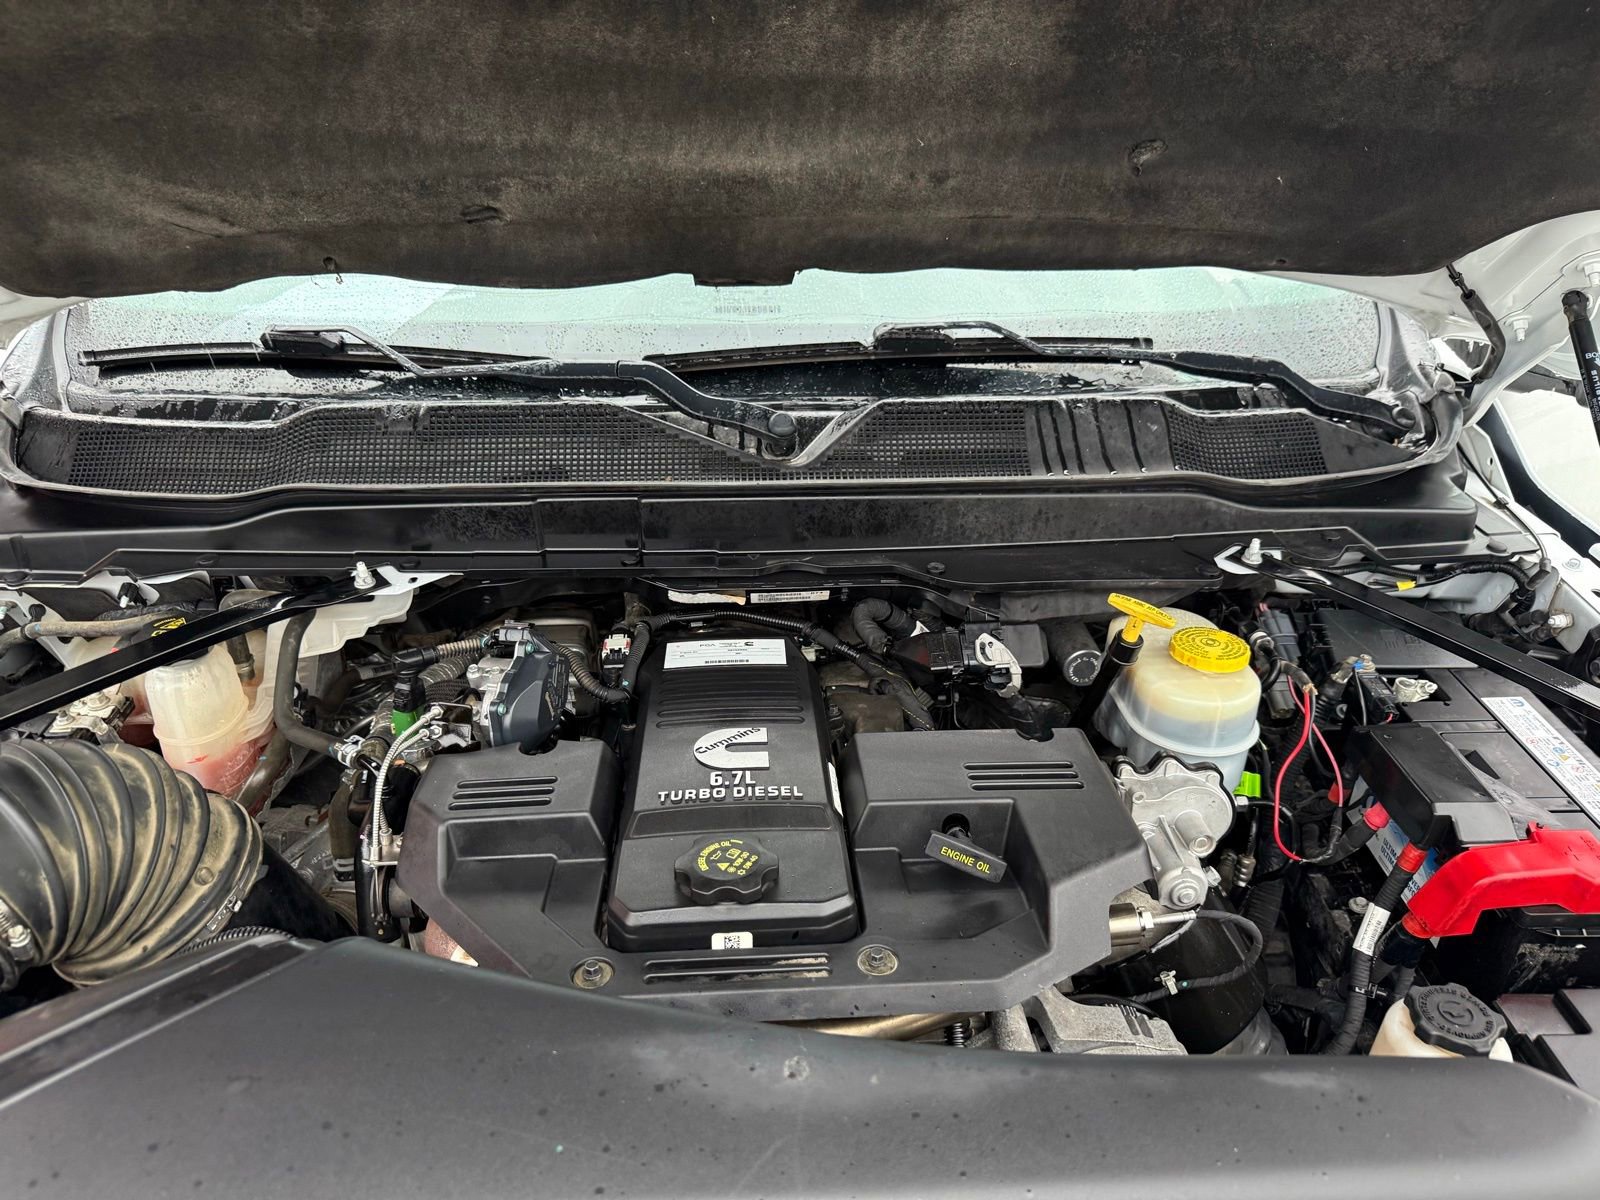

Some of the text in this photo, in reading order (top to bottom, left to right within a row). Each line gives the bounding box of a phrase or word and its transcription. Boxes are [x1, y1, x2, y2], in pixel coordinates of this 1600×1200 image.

[694, 727, 761, 755] Cummins
[710, 770, 756, 786] 6.7L
[658, 785, 803, 802] TURBO DIESEL
[720, 840, 731, 848] OIL
[940, 846, 991, 874] ENGINE OIL
